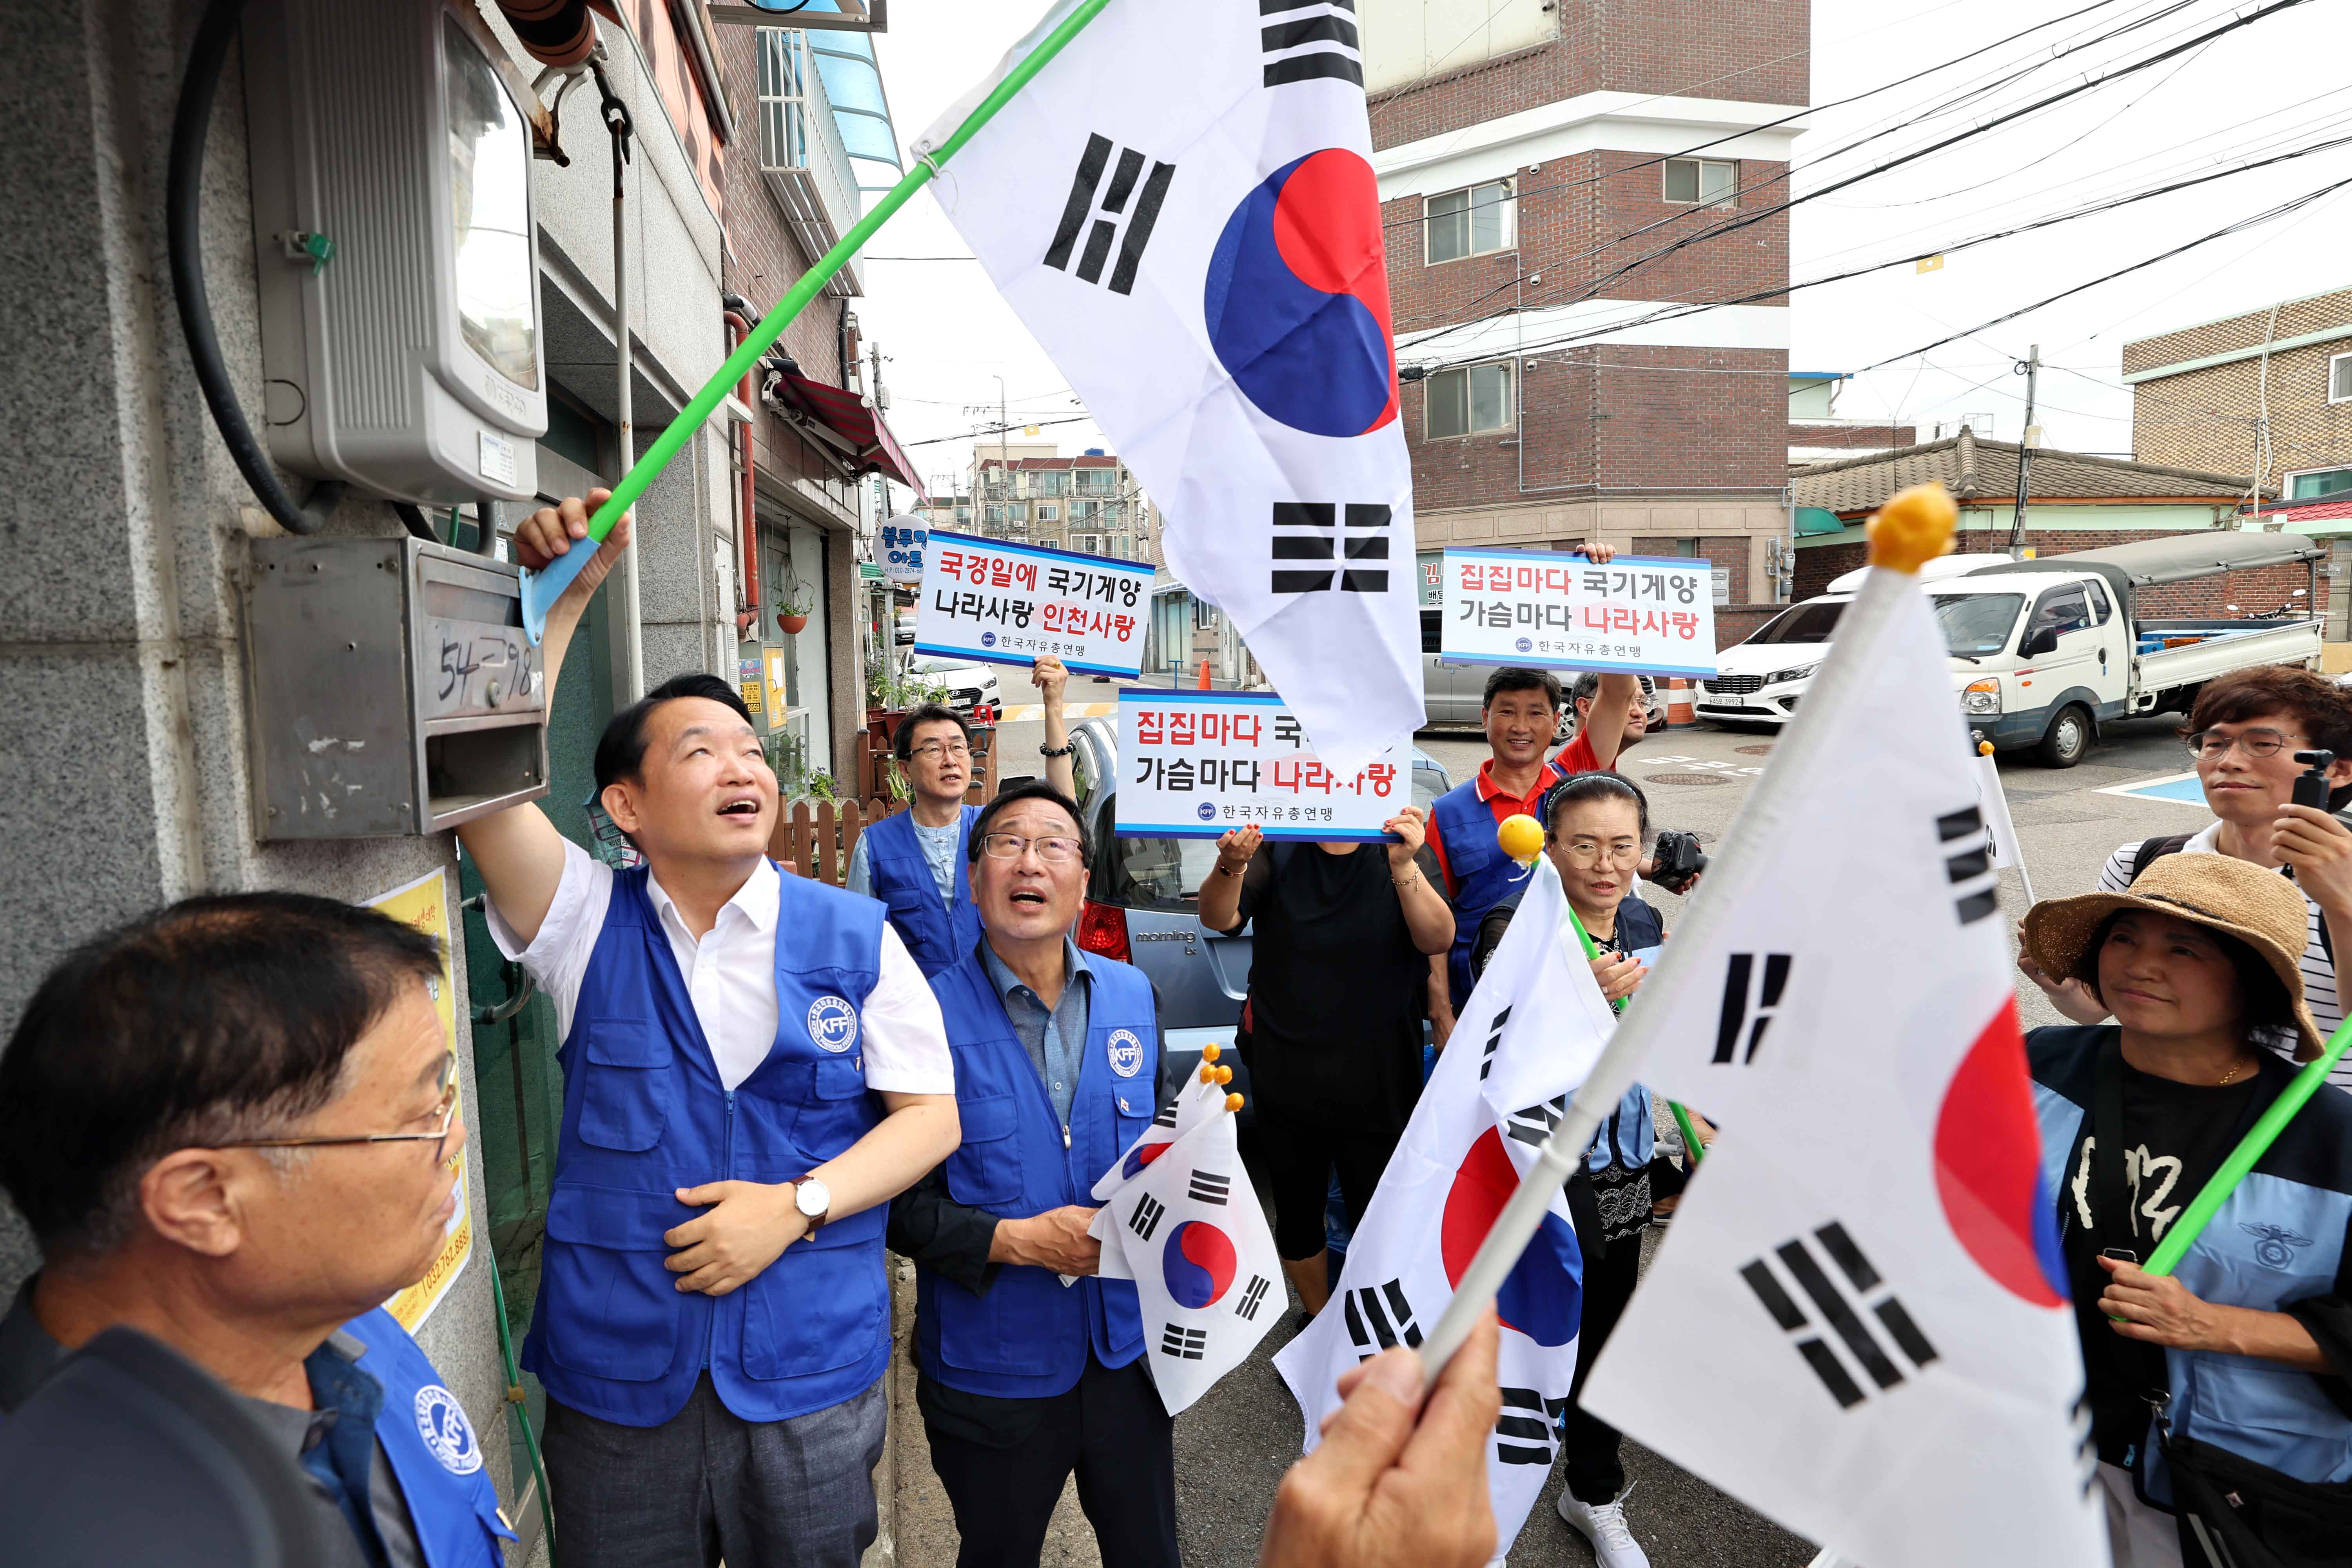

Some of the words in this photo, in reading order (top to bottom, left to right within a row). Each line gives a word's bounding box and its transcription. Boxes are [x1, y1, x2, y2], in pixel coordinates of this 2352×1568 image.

[888, 551, 923, 568] 아트
[940, 551, 1038, 591] 국경일에
[1048, 567, 1142, 607] 국기게양
[1461, 564, 1572, 595] 집집마다
[1583, 571, 1697, 604] 국기게양
[935, 589, 1034, 629] 나라사랑
[1044, 604, 1136, 642] 인천사랑
[1460, 600, 1572, 632] 가슴마다
[1584, 607, 1699, 640] 나라사랑
[1001, 636, 1085, 656] 한국자유총연맹
[1539, 641, 1641, 657] 한국자유총연맹
[1138, 712, 1262, 747] 집집마다
[1136, 758, 1261, 793] 가슴마다
[1222, 805, 1332, 821] 한국자유총연맹
[1137, 930, 1195, 943] morning
[818, 1016, 848, 1034] KFF
[1115, 1047, 1135, 1061] KFF
